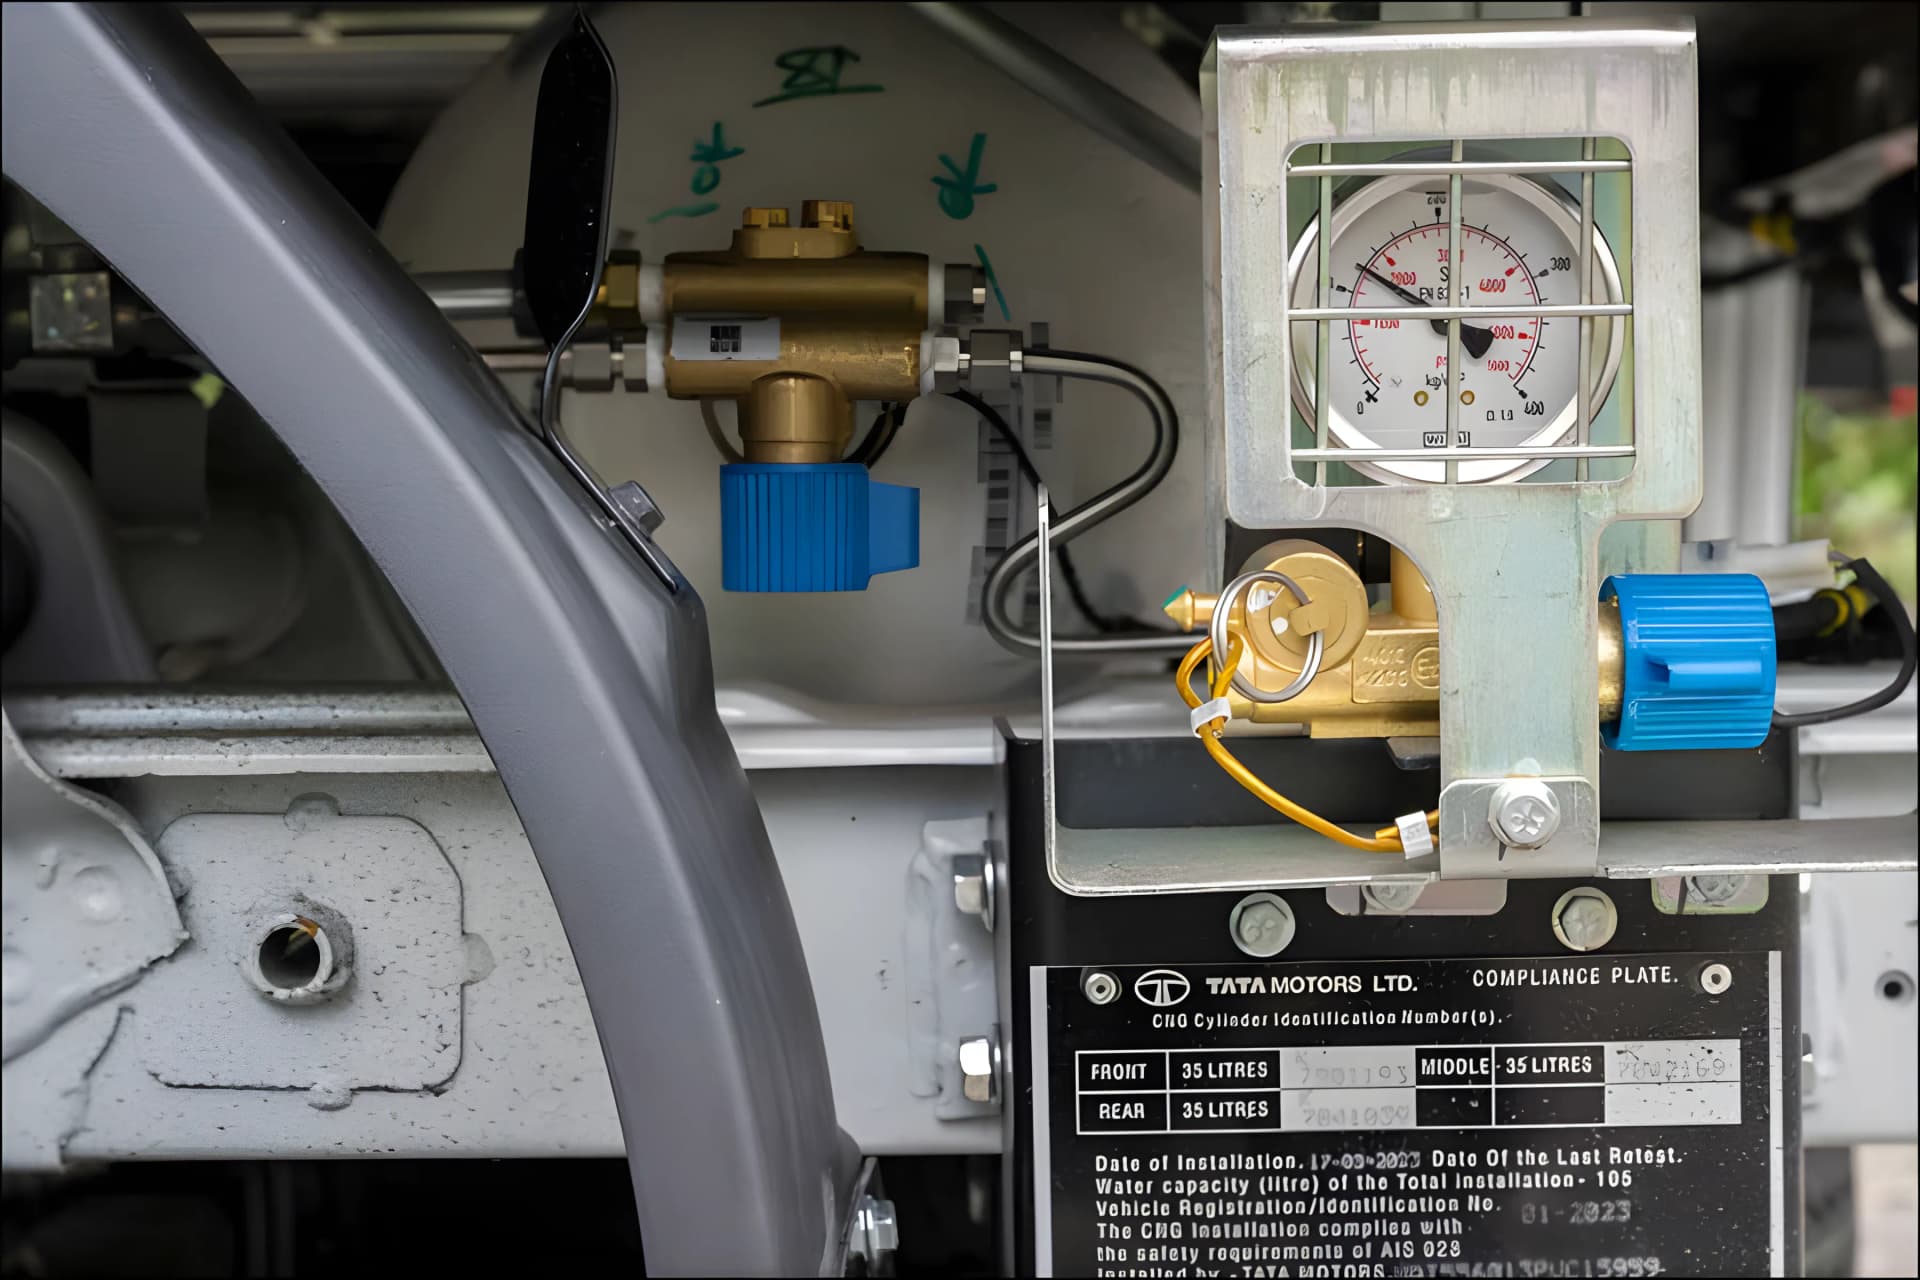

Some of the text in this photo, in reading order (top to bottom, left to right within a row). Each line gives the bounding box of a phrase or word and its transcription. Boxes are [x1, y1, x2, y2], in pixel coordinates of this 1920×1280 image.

[1206, 975, 1417, 994] TATA MOTORS LTD.
[1473, 966, 1678, 986] COMPLIANCE PLATE.
[1092, 1064, 1147, 1080] FRONT
[1183, 1062, 1267, 1079] 35 LITRES
[1422, 1058, 1489, 1075] MIDDLE
[1532, 1056, 1591, 1073] LITRES
[1100, 1103, 1144, 1119] REAR
[1183, 1101, 1268, 1119] 35 LITRES
[1096, 1155, 1139, 1172] Date
[1150, 1155, 1168, 1171] of
[1433, 1150, 1476, 1167] Date
[1487, 1149, 1508, 1167] Of
[1517, 1149, 1549, 1166] the
[1557, 1149, 1600, 1165] Last
[1096, 1178, 1152, 1194] Water
[1163, 1177, 1249, 1196] capacity
[1260, 1175, 1318, 1195] (litre)
[1329, 1174, 1347, 1191] of
[1357, 1174, 1387, 1190] the
[1397, 1173, 1446, 1190] Total
[1096, 1200, 1169, 1216] Vehicle
[1097, 1223, 1131, 1239] The
[1192, 1221, 1309, 1238] Installation
[1319, 1219, 1410, 1239] complies
[1420, 1218, 1462, 1235] with
[1097, 1246, 1126, 1261] the
[1137, 1245, 1198, 1264] safety
[1209, 1244, 1342, 1263] requirements
[1353, 1242, 1371, 1258] of
[1381, 1241, 1414, 1258] AIS
